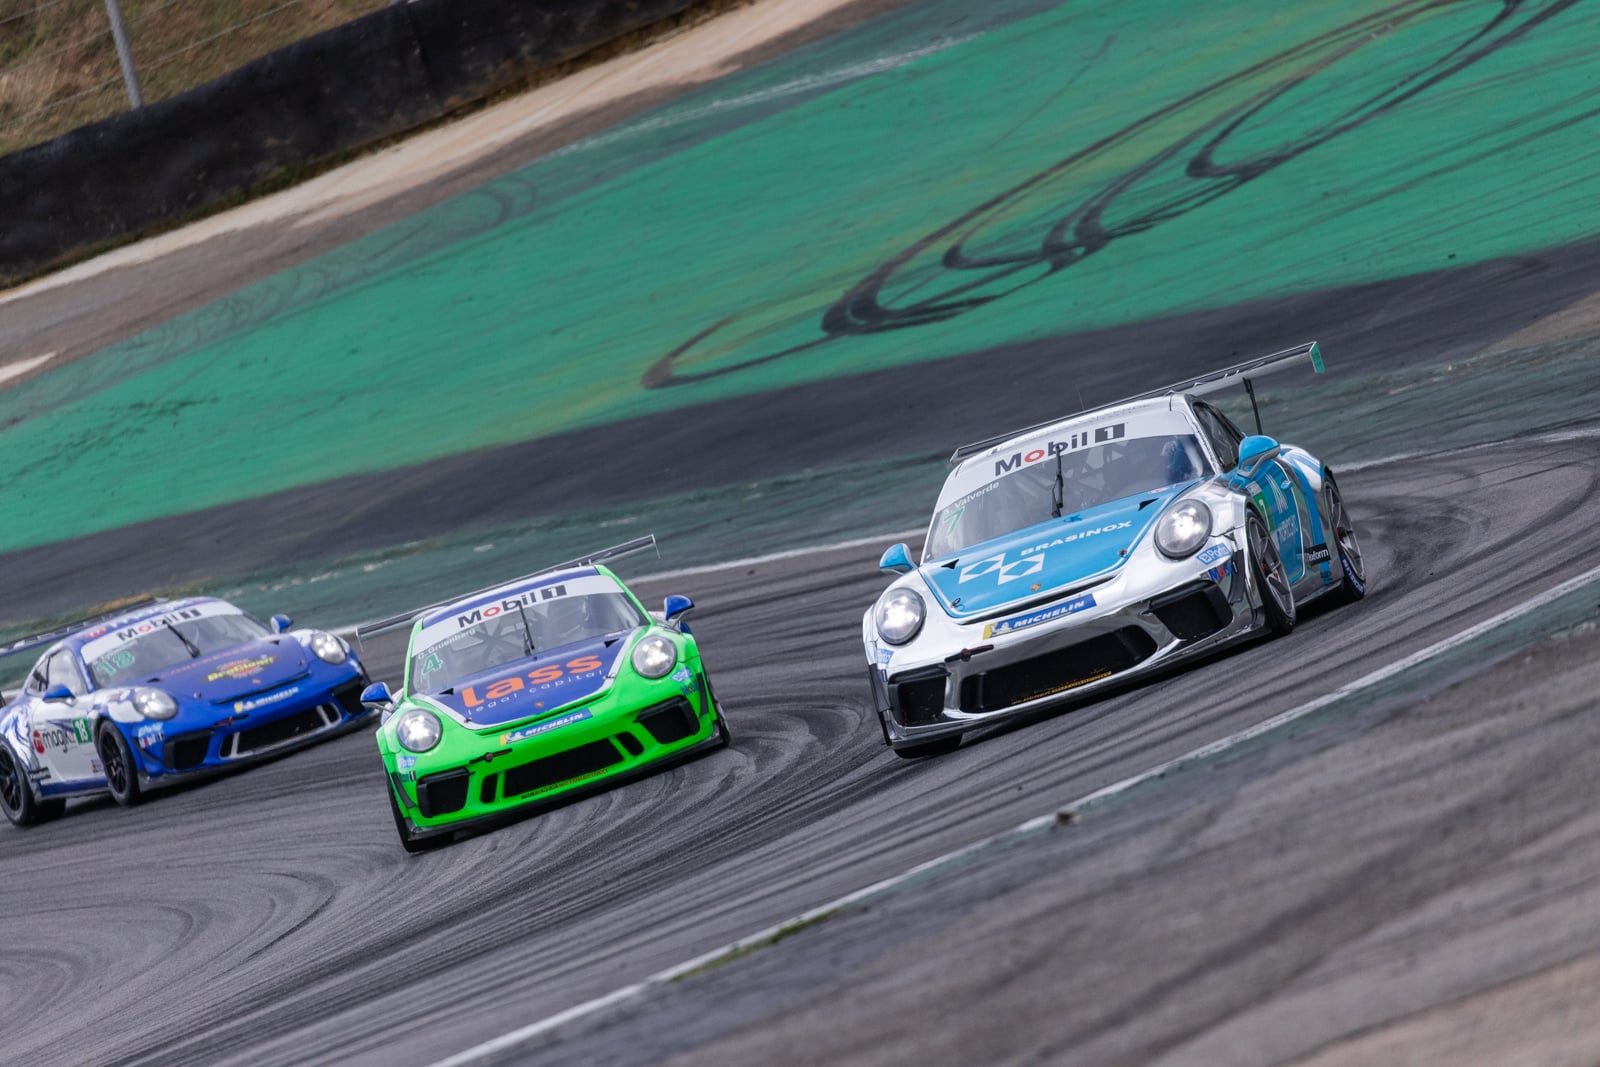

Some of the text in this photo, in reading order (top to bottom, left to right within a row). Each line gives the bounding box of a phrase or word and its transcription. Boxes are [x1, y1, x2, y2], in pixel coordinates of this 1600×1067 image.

[995, 431, 1088, 476] Mobil
[954, 481, 1000, 508] Valverde
[943, 506, 965, 537] 7
[1020, 520, 1133, 556] BRASINOX
[458, 592, 537, 628] Mobil
[1013, 600, 1085, 629] MICHELIN
[117, 612, 178, 641] Mobil
[95, 651, 135, 676] 18
[422, 652, 443, 675] 4
[461, 655, 603, 708] lass
[467, 670, 603, 715] legal capital
[75, 718, 89, 741] 18
[524, 713, 583, 736] MICHELIN
